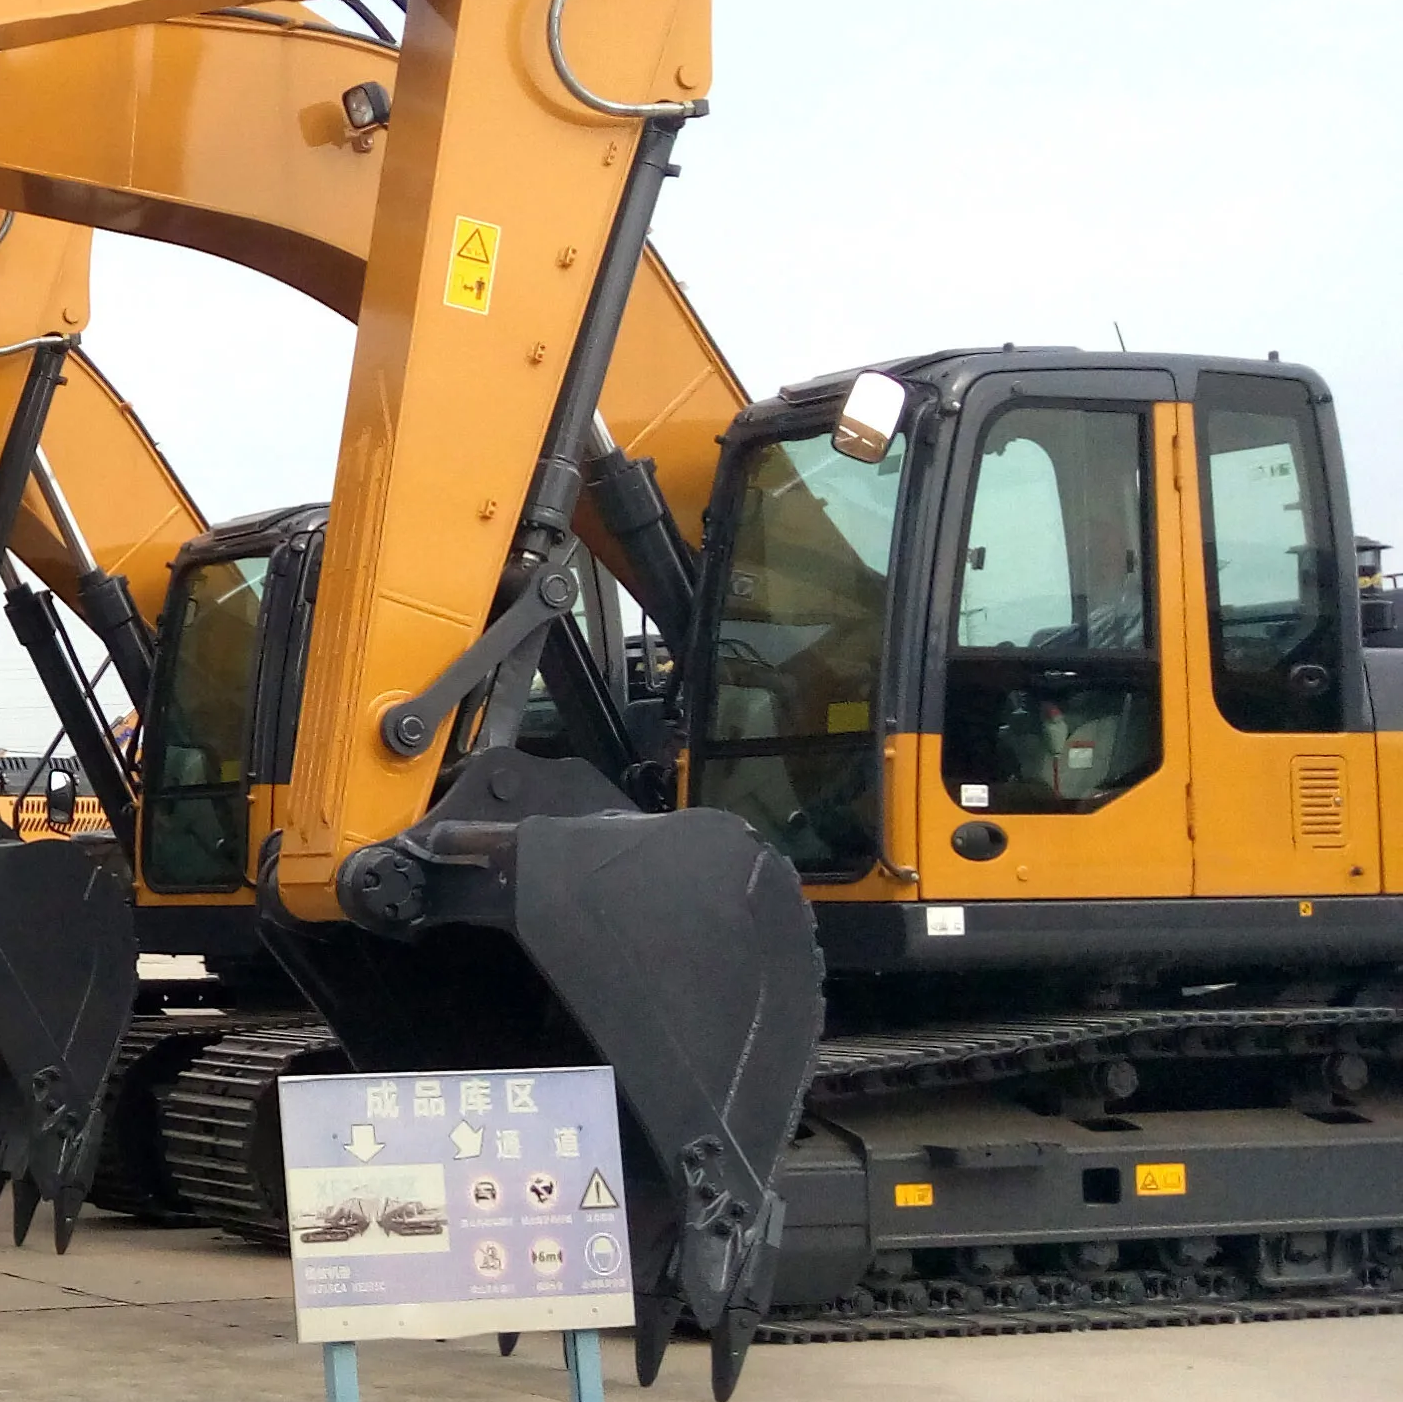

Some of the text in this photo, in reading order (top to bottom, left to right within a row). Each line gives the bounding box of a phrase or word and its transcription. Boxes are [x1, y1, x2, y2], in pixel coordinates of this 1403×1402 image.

[366, 1078, 539, 1119] 成品库区
[537, 1251, 557, 1263] 6m
